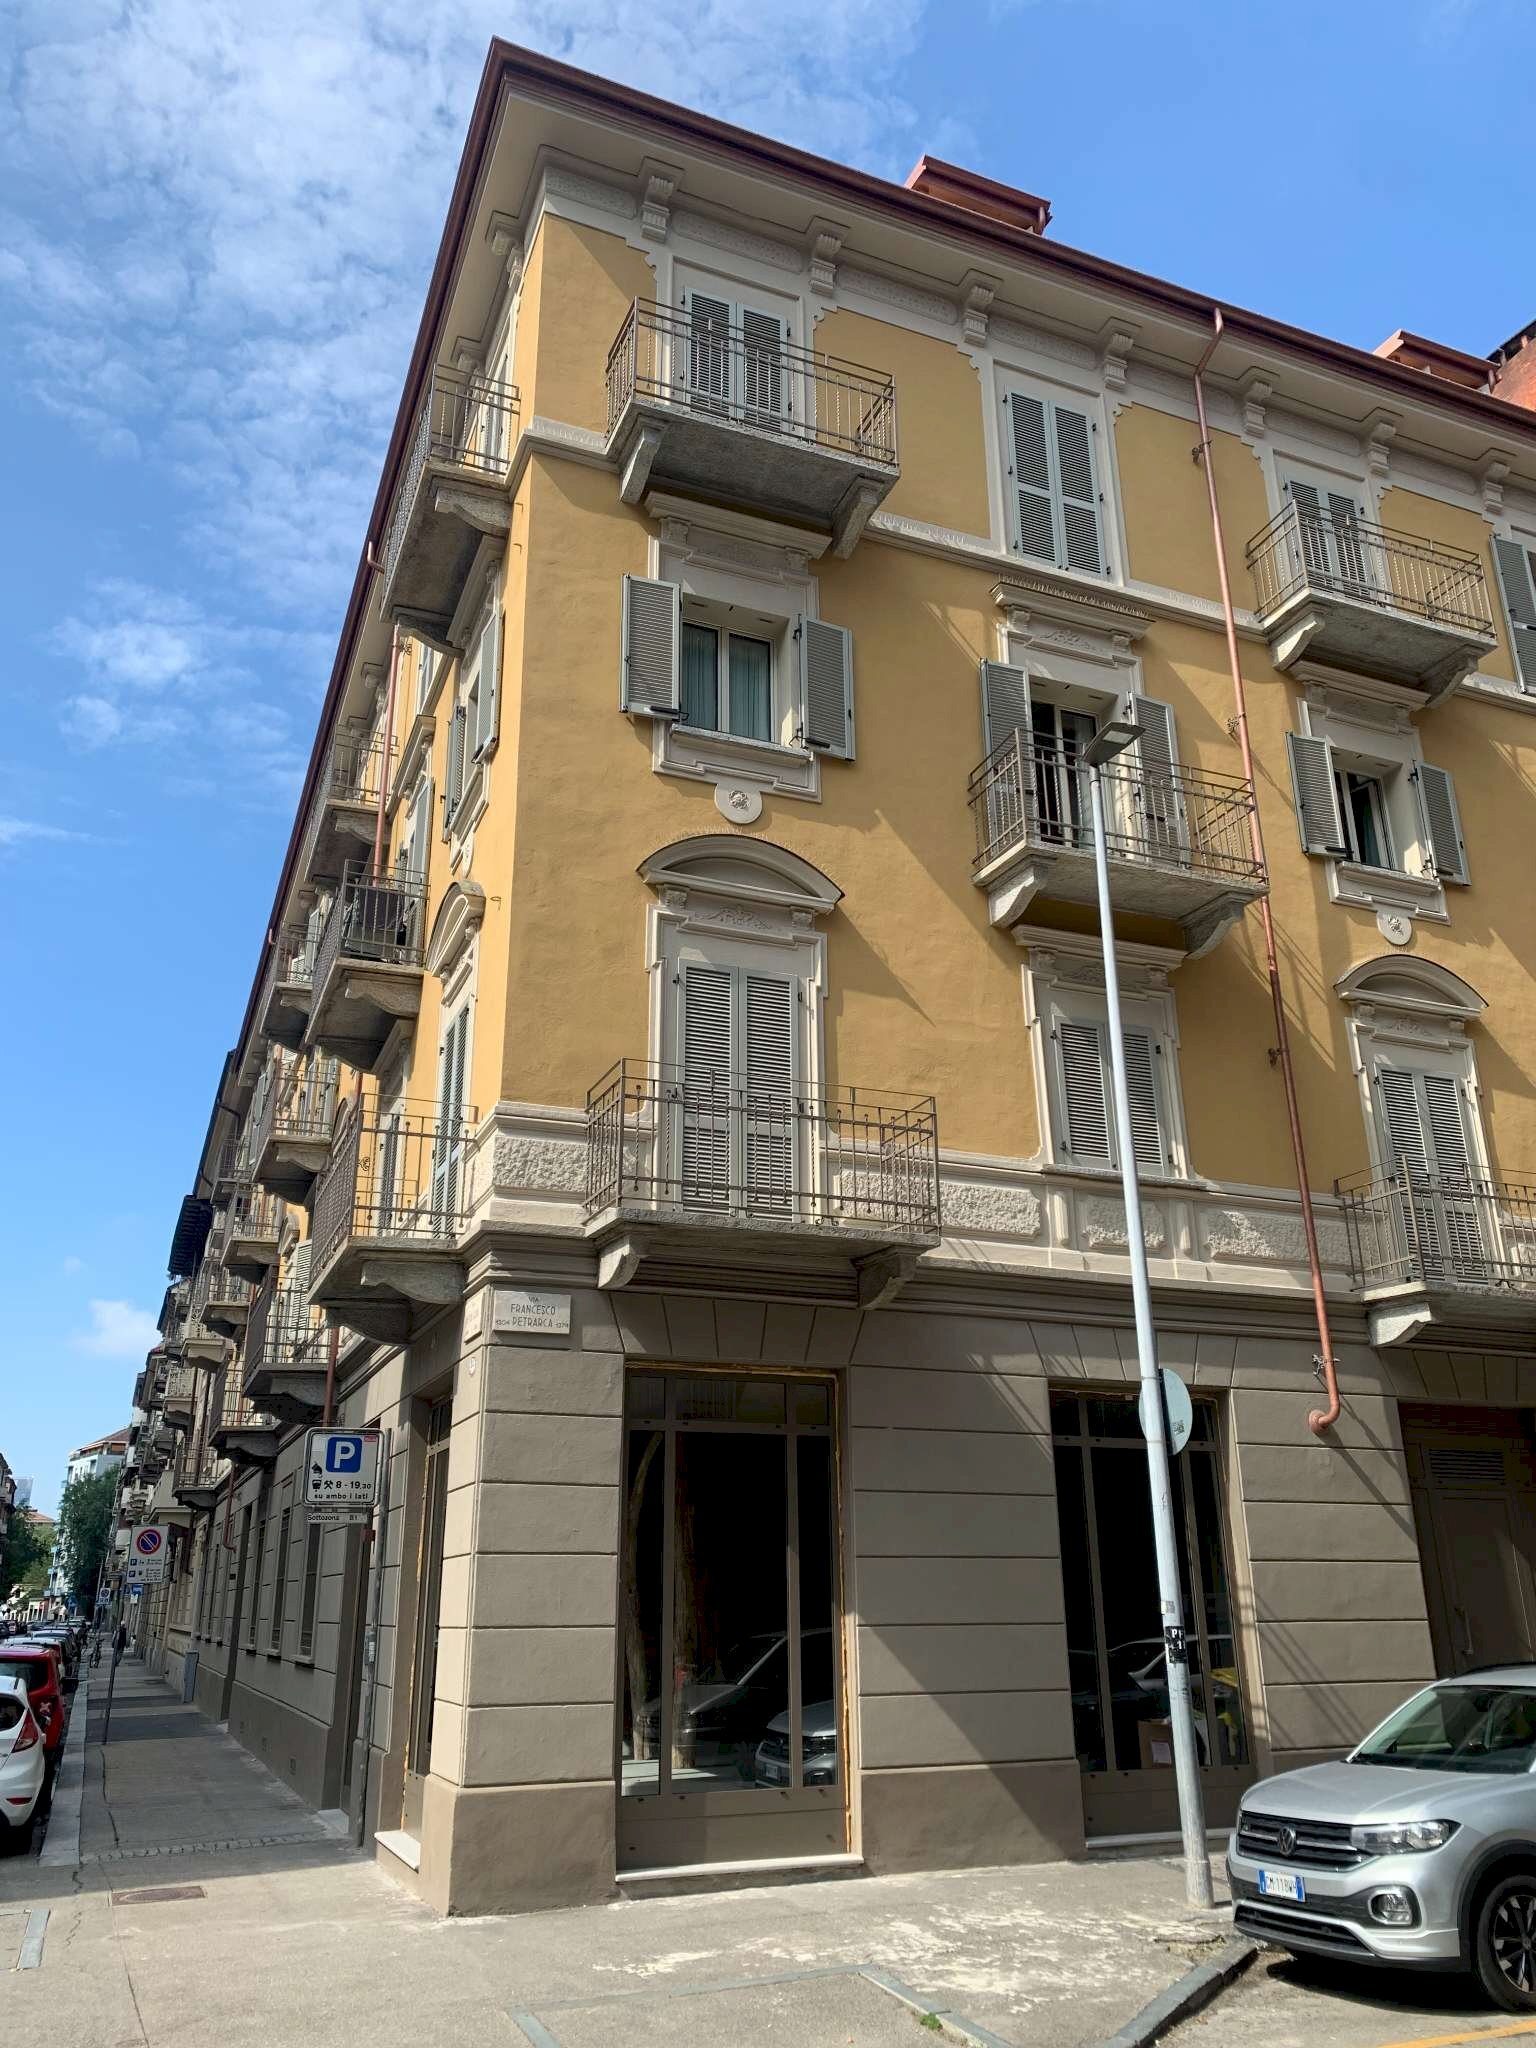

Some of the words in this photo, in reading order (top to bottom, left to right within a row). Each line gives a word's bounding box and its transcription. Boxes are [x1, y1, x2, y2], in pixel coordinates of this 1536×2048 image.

[510, 1304, 556, 1315] FRANCESCO
[512, 1317, 553, 1328] PETRARCA
[334, 1441, 355, 1469] P
[335, 1480, 342, 1489] 8
